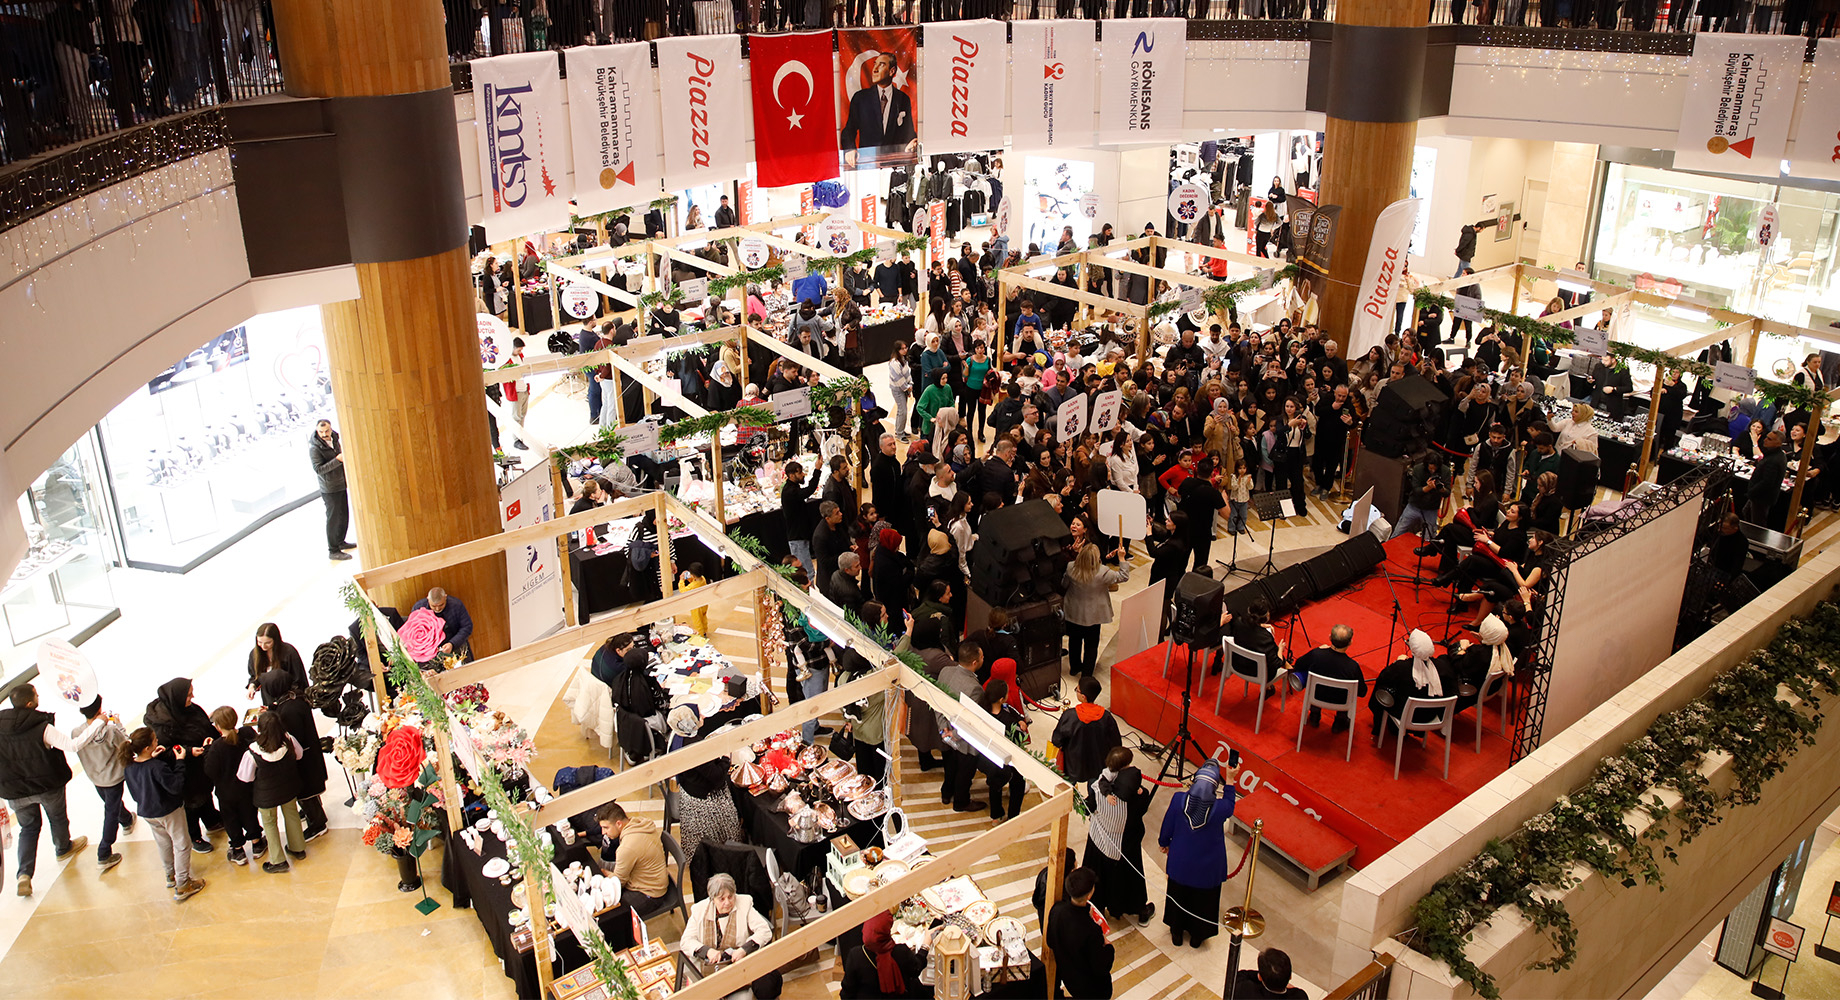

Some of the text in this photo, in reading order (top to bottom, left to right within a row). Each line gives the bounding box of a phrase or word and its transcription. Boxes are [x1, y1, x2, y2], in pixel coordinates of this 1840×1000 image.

[595, 67, 612, 168] Büyükşehir Belediyesi
[607, 66, 620, 166] Kahramanmaraş
[686, 51, 715, 169] Piazza
[951, 35, 979, 138] Piazza
[1129, 61, 1140, 131] GAYRİMENKUL
[1140, 61, 1155, 130] RÖNESANS
[1714, 53, 1740, 136] Büyükşehir Belediyesi
[1728, 53, 1755, 137] Kahramanmaraş
[1363, 247, 1399, 319] Piazza
[522, 572, 545, 592] KİGEM
